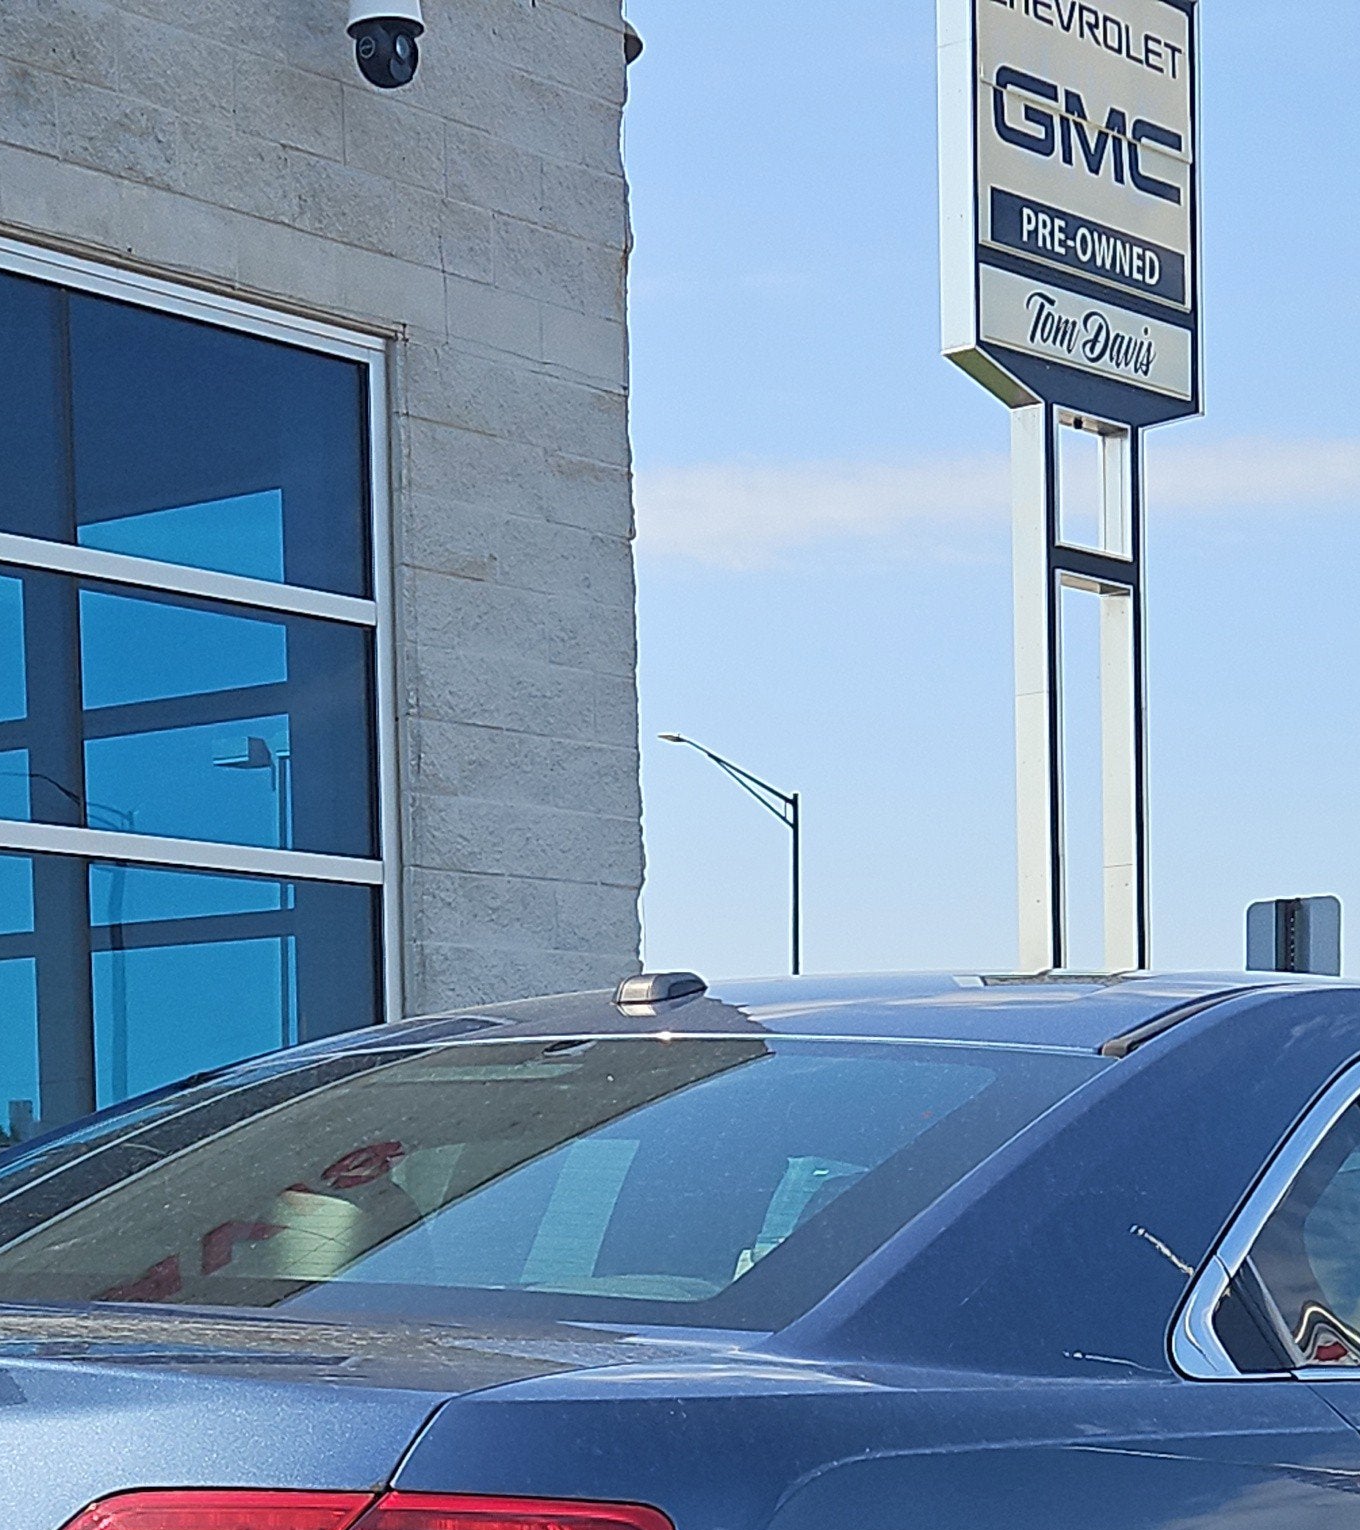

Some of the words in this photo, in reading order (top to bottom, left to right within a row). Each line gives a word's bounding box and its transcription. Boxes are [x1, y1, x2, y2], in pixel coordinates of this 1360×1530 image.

[991, 0, 1182, 79] EVROLET
[993, 65, 1182, 205] GMC
[1021, 207, 1160, 286] PRE-OWNED
[1026, 291, 1078, 354] Tom
[1082, 310, 1156, 376] Davis
